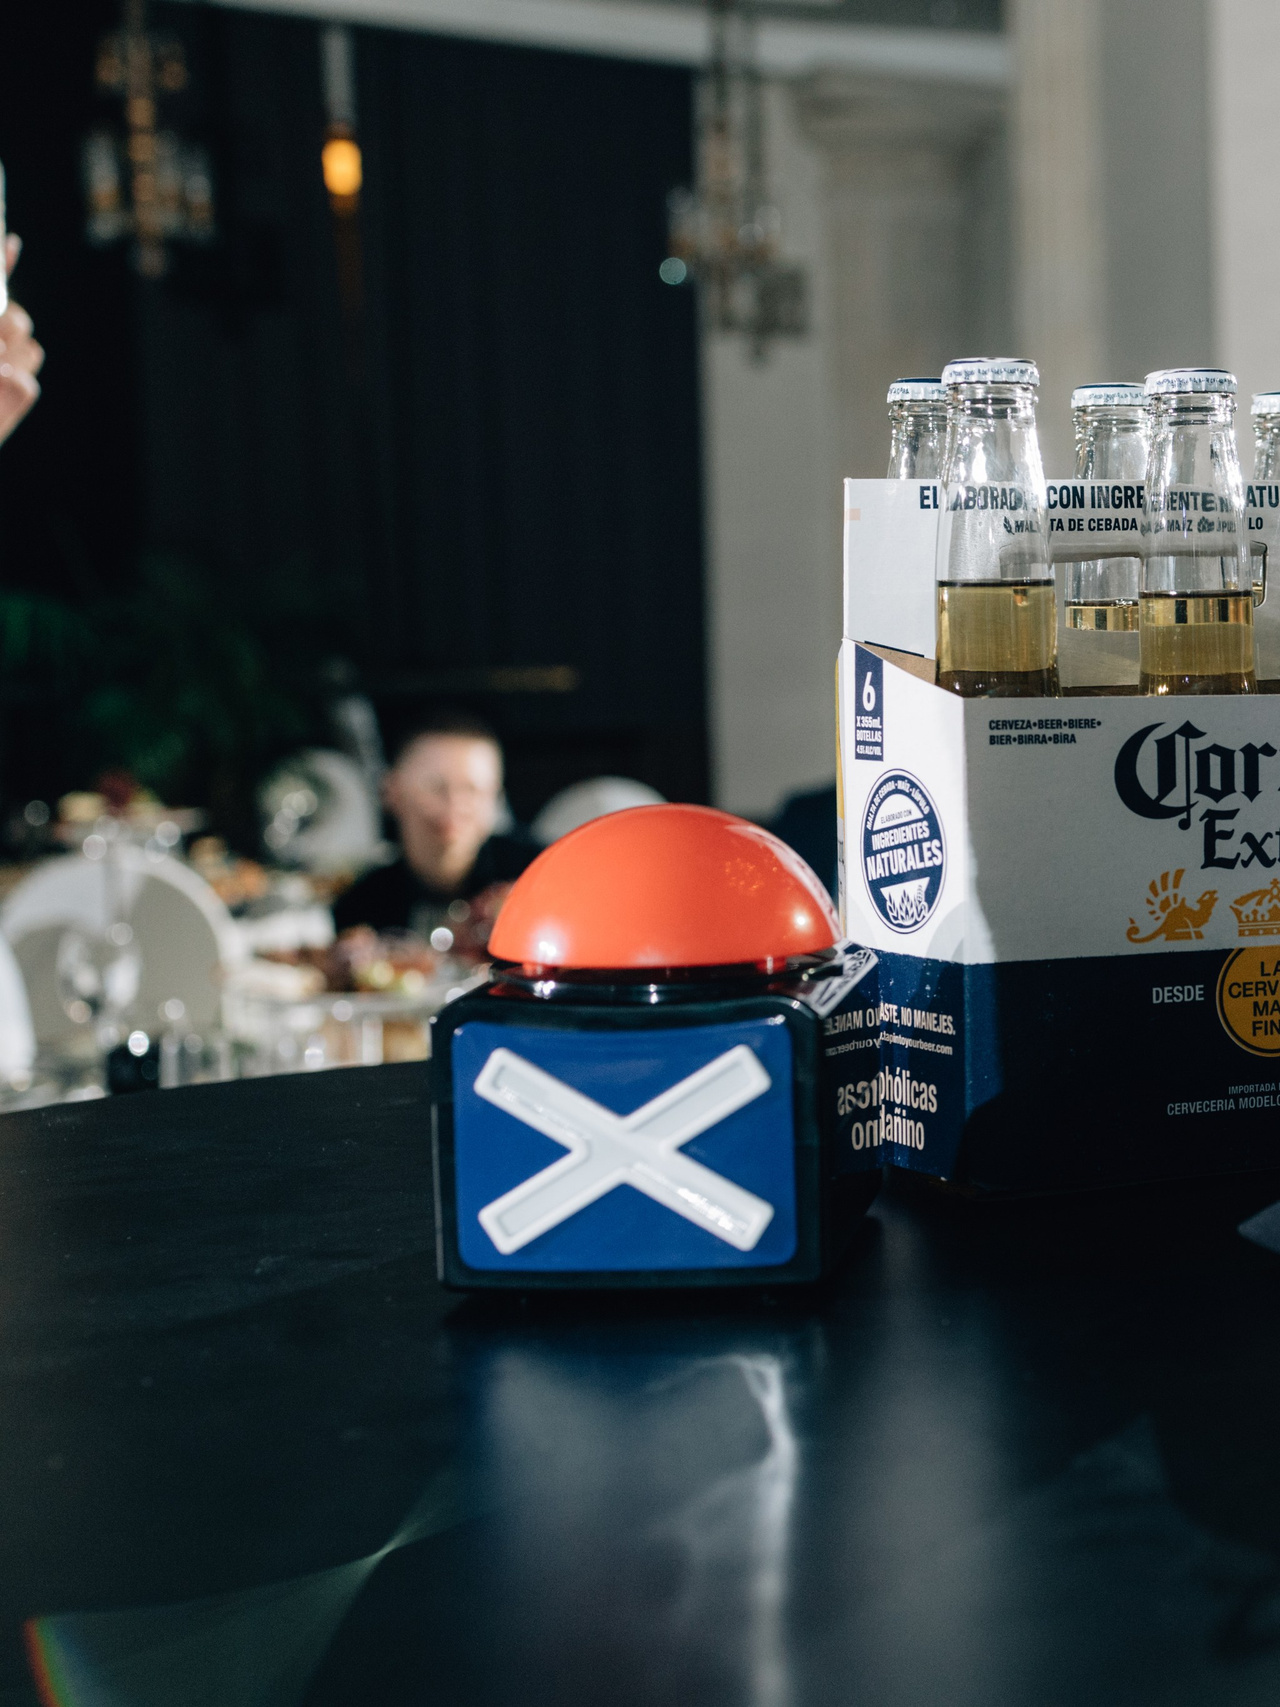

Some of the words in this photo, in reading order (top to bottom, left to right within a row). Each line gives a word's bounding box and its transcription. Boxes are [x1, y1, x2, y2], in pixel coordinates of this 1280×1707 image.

[1046, 485, 1085, 510] CON
[1068, 518, 1084, 532] DE
[1088, 517, 1139, 532] CEBADA
[862, 671, 876, 712] 6
[861, 716, 882, 729] 355mL
[856, 729, 882, 743] BOTELLAS
[866, 803, 877, 831] MALTA
[871, 820, 930, 851] INGREDIENTES
[866, 838, 943, 882] NATURALES
[1152, 984, 1205, 1004] DESDE
[901, 1006, 913, 1027] NO
[913, 1008, 956, 1036] MANEJES.
[1228, 1082, 1277, 1096] IMPORTADA
[1166, 1098, 1236, 1116] CERVECERIA
